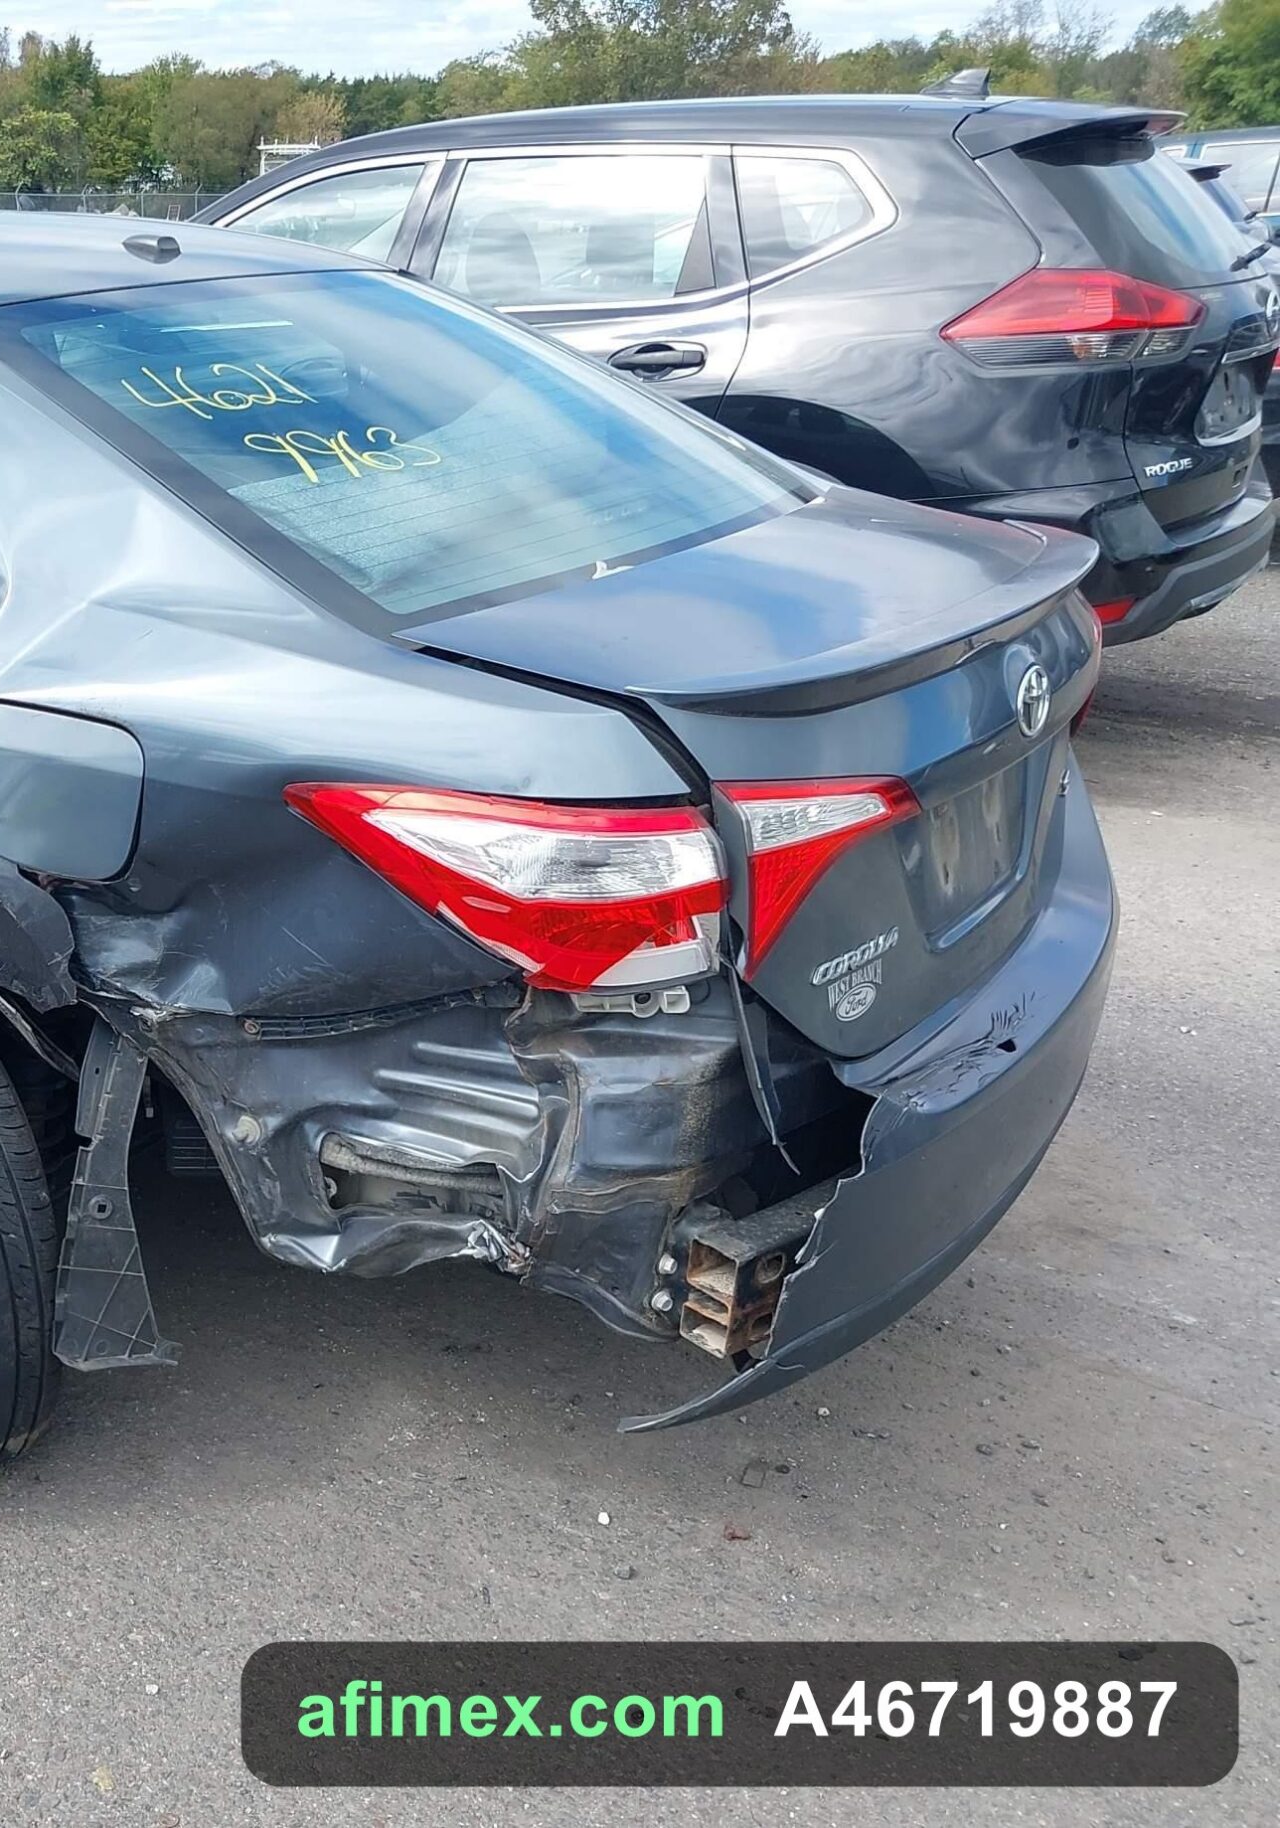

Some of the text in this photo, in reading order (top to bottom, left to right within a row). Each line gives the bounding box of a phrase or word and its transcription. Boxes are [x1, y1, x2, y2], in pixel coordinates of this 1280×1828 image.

[121, 363, 318, 419] 4621
[243, 427, 441, 483] 9963
[1144, 457, 1194, 478] ROGUE
[811, 925, 899, 986] COROLLA
[844, 990, 869, 1015] Ford
